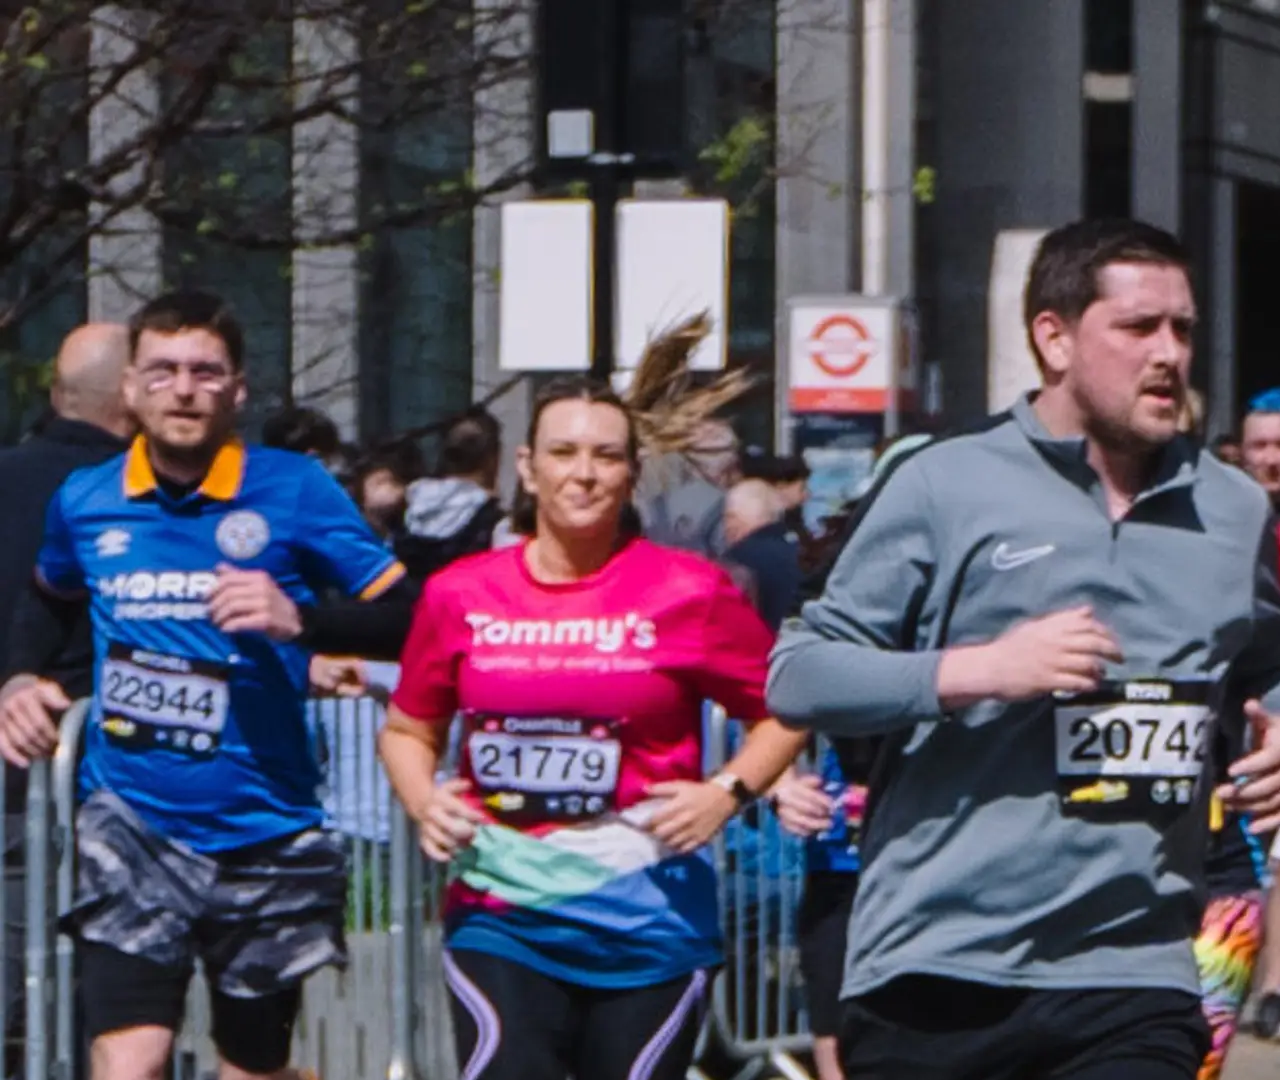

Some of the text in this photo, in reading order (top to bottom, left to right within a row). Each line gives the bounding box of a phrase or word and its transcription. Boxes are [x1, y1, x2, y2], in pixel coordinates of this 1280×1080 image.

[464, 612, 656, 652] Tommy's
[108, 670, 213, 718] 22944
[479, 744, 605, 782] 21779
